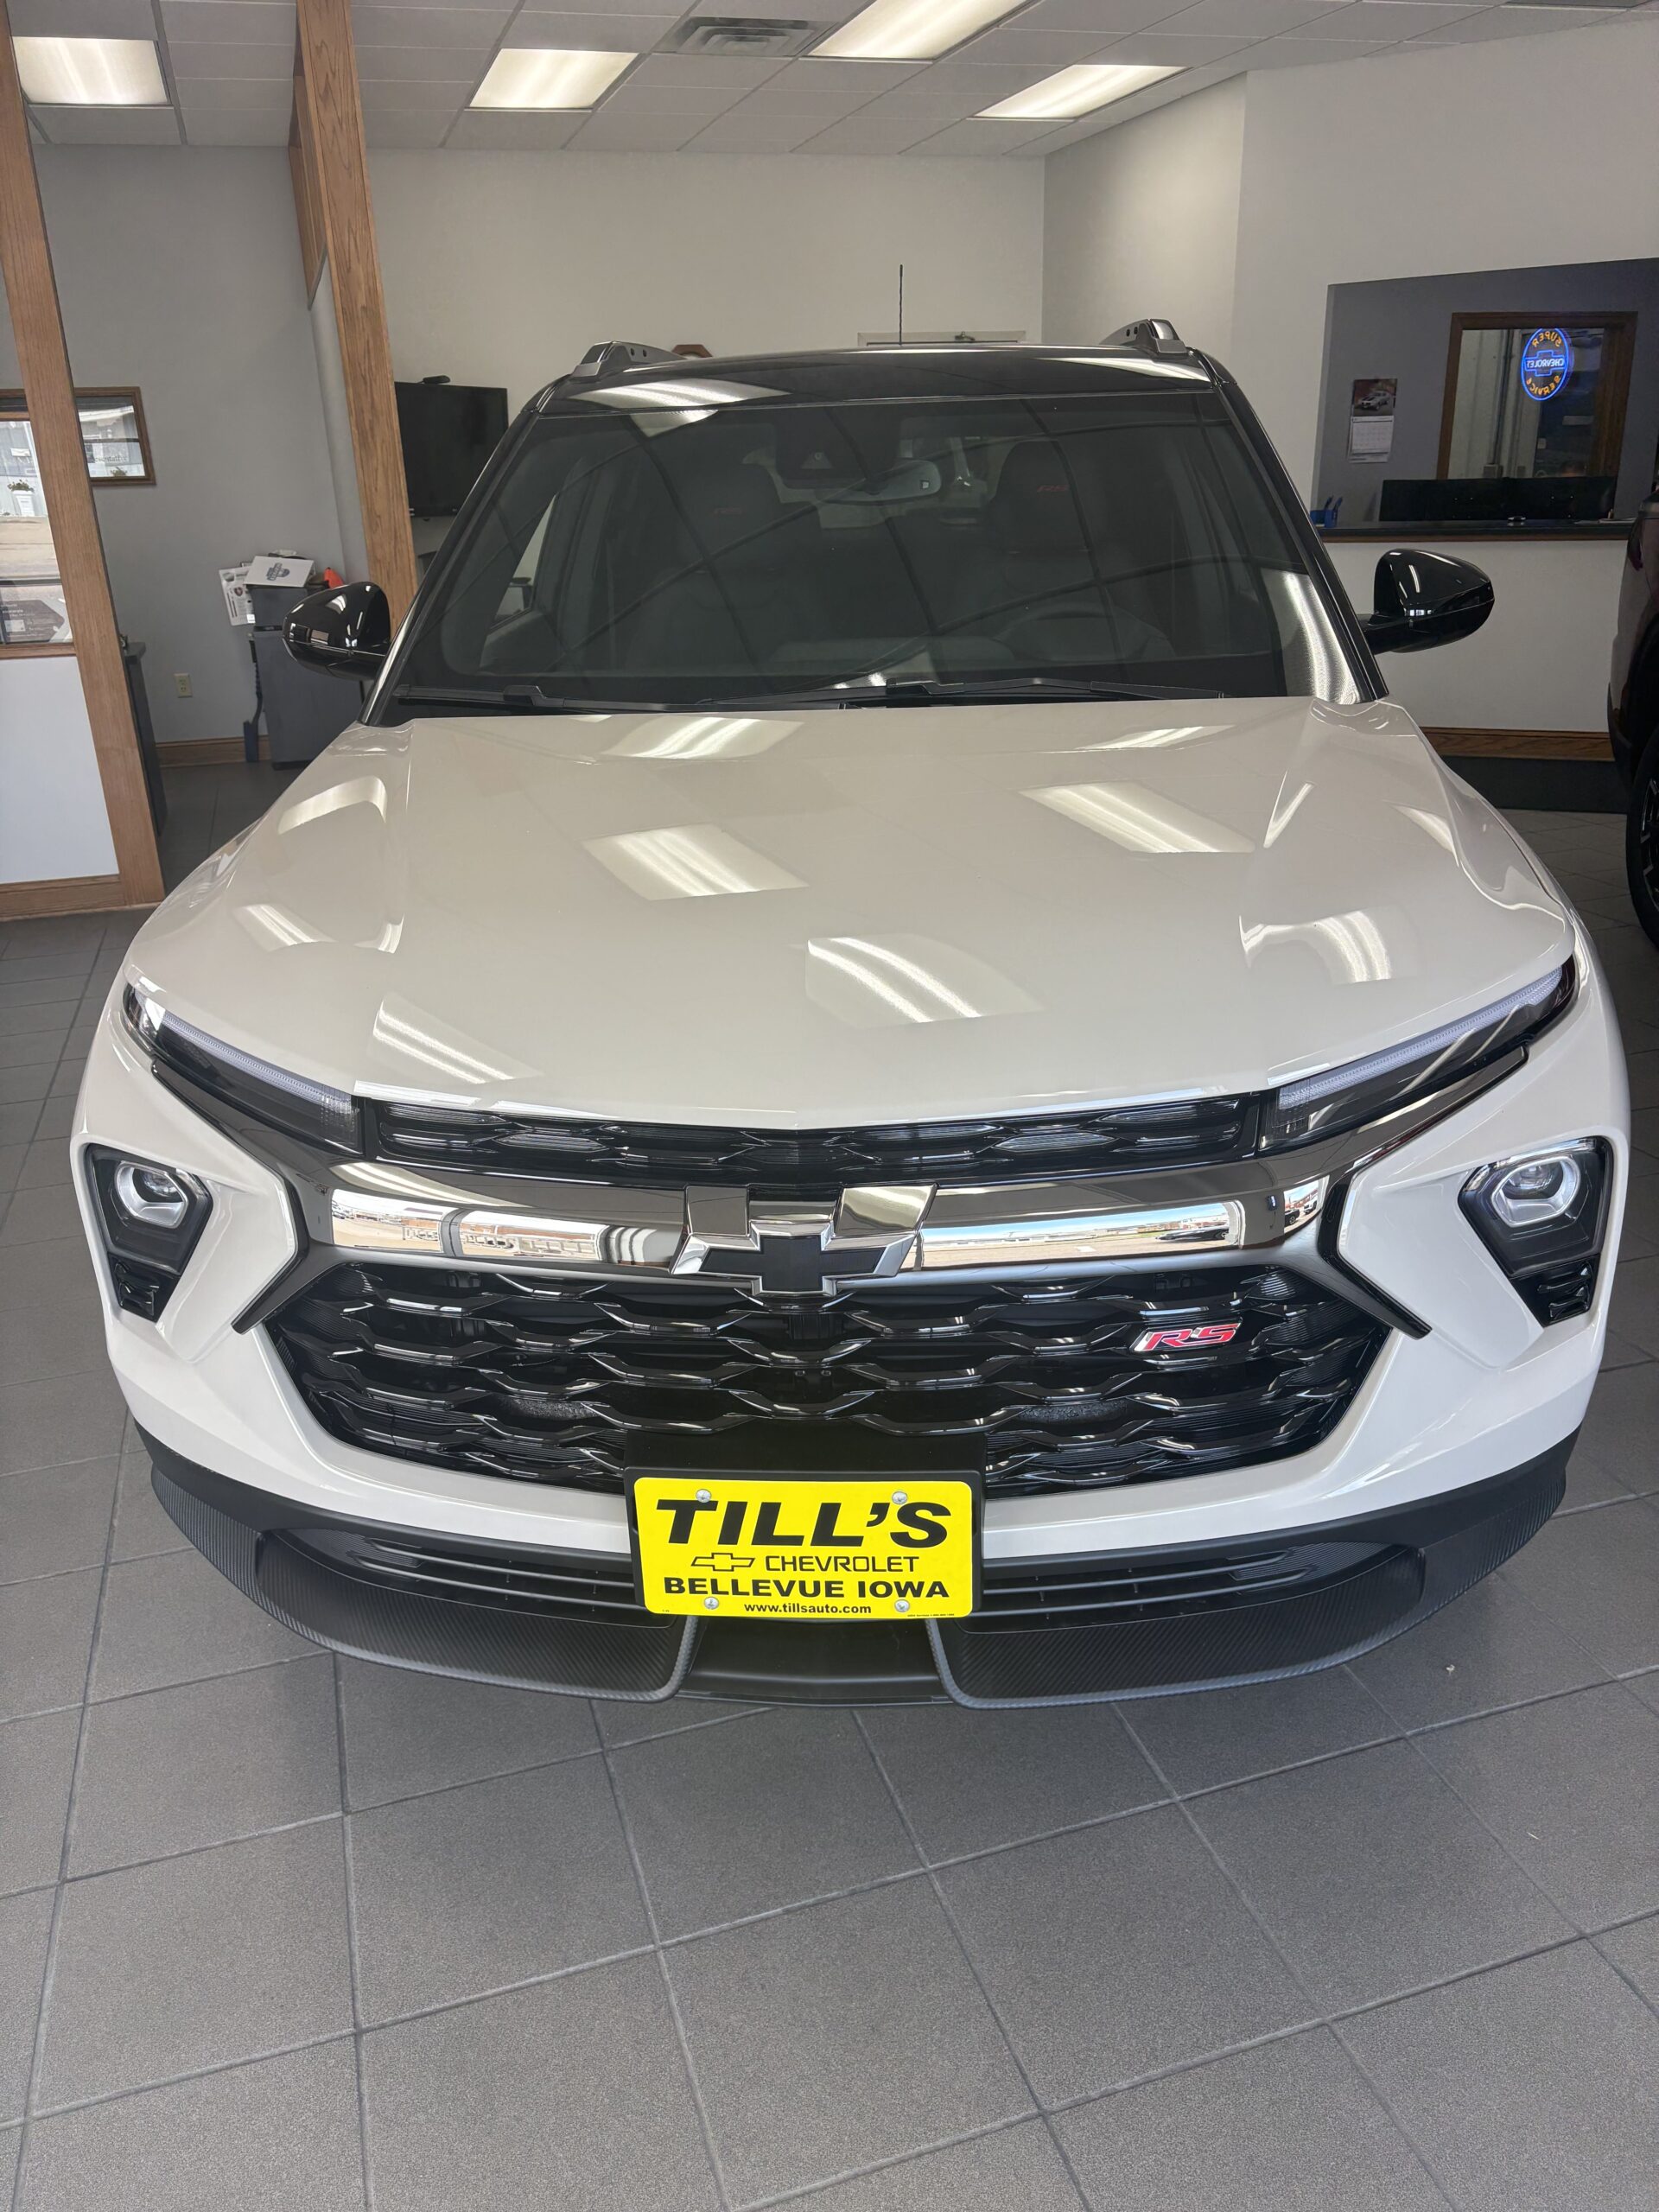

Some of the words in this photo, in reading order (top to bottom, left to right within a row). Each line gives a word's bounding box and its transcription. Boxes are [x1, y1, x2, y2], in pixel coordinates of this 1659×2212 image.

[1135, 1323, 1242, 1351] RS
[657, 1498, 951, 1548] TILL'S
[765, 1555, 920, 1573] CHEVROLET
[664, 1577, 845, 1598] BELLEVUE
[857, 1580, 950, 1598] IOWA
[743, 1602, 872, 1614] www.tillsauto.com
